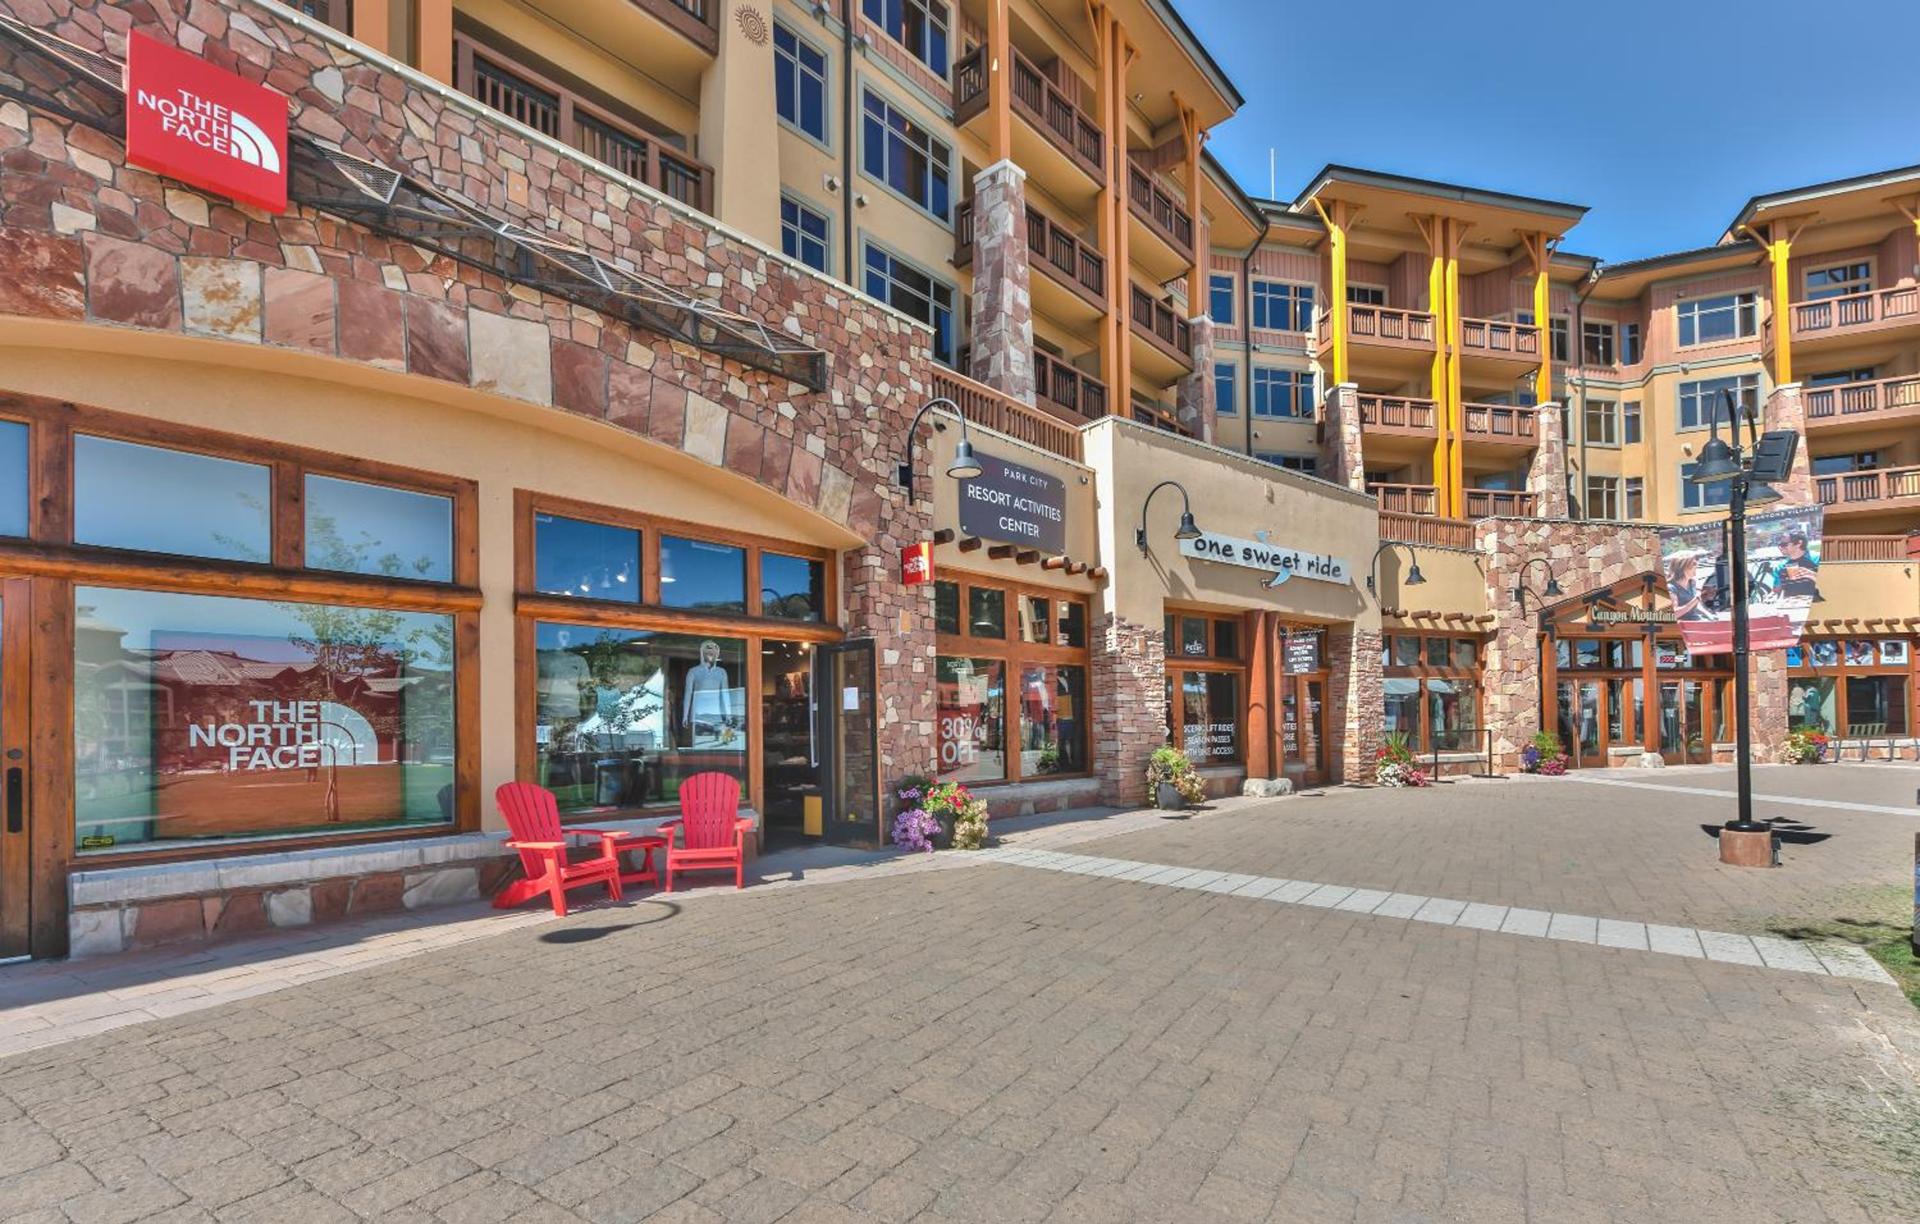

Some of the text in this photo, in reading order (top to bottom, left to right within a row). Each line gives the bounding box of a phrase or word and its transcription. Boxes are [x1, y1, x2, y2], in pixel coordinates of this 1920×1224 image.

[136, 88, 229, 139] NORTH
[176, 88, 228, 122] THE
[162, 115, 228, 155] FACE
[1003, 467, 1048, 489] PARK CITY
[967, 484, 1062, 522] RESORT ACTIVITIES
[999, 516, 1041, 539] CENTER
[1194, 537, 1343, 578] one sweet ride
[1591, 605, 1678, 625] Canyon Mountain
[249, 700, 318, 723] THE
[189, 723, 318, 748] NORTH
[941, 716, 985, 739] 30%
[229, 746, 318, 771] FACE
[941, 740, 980, 764] OFF
